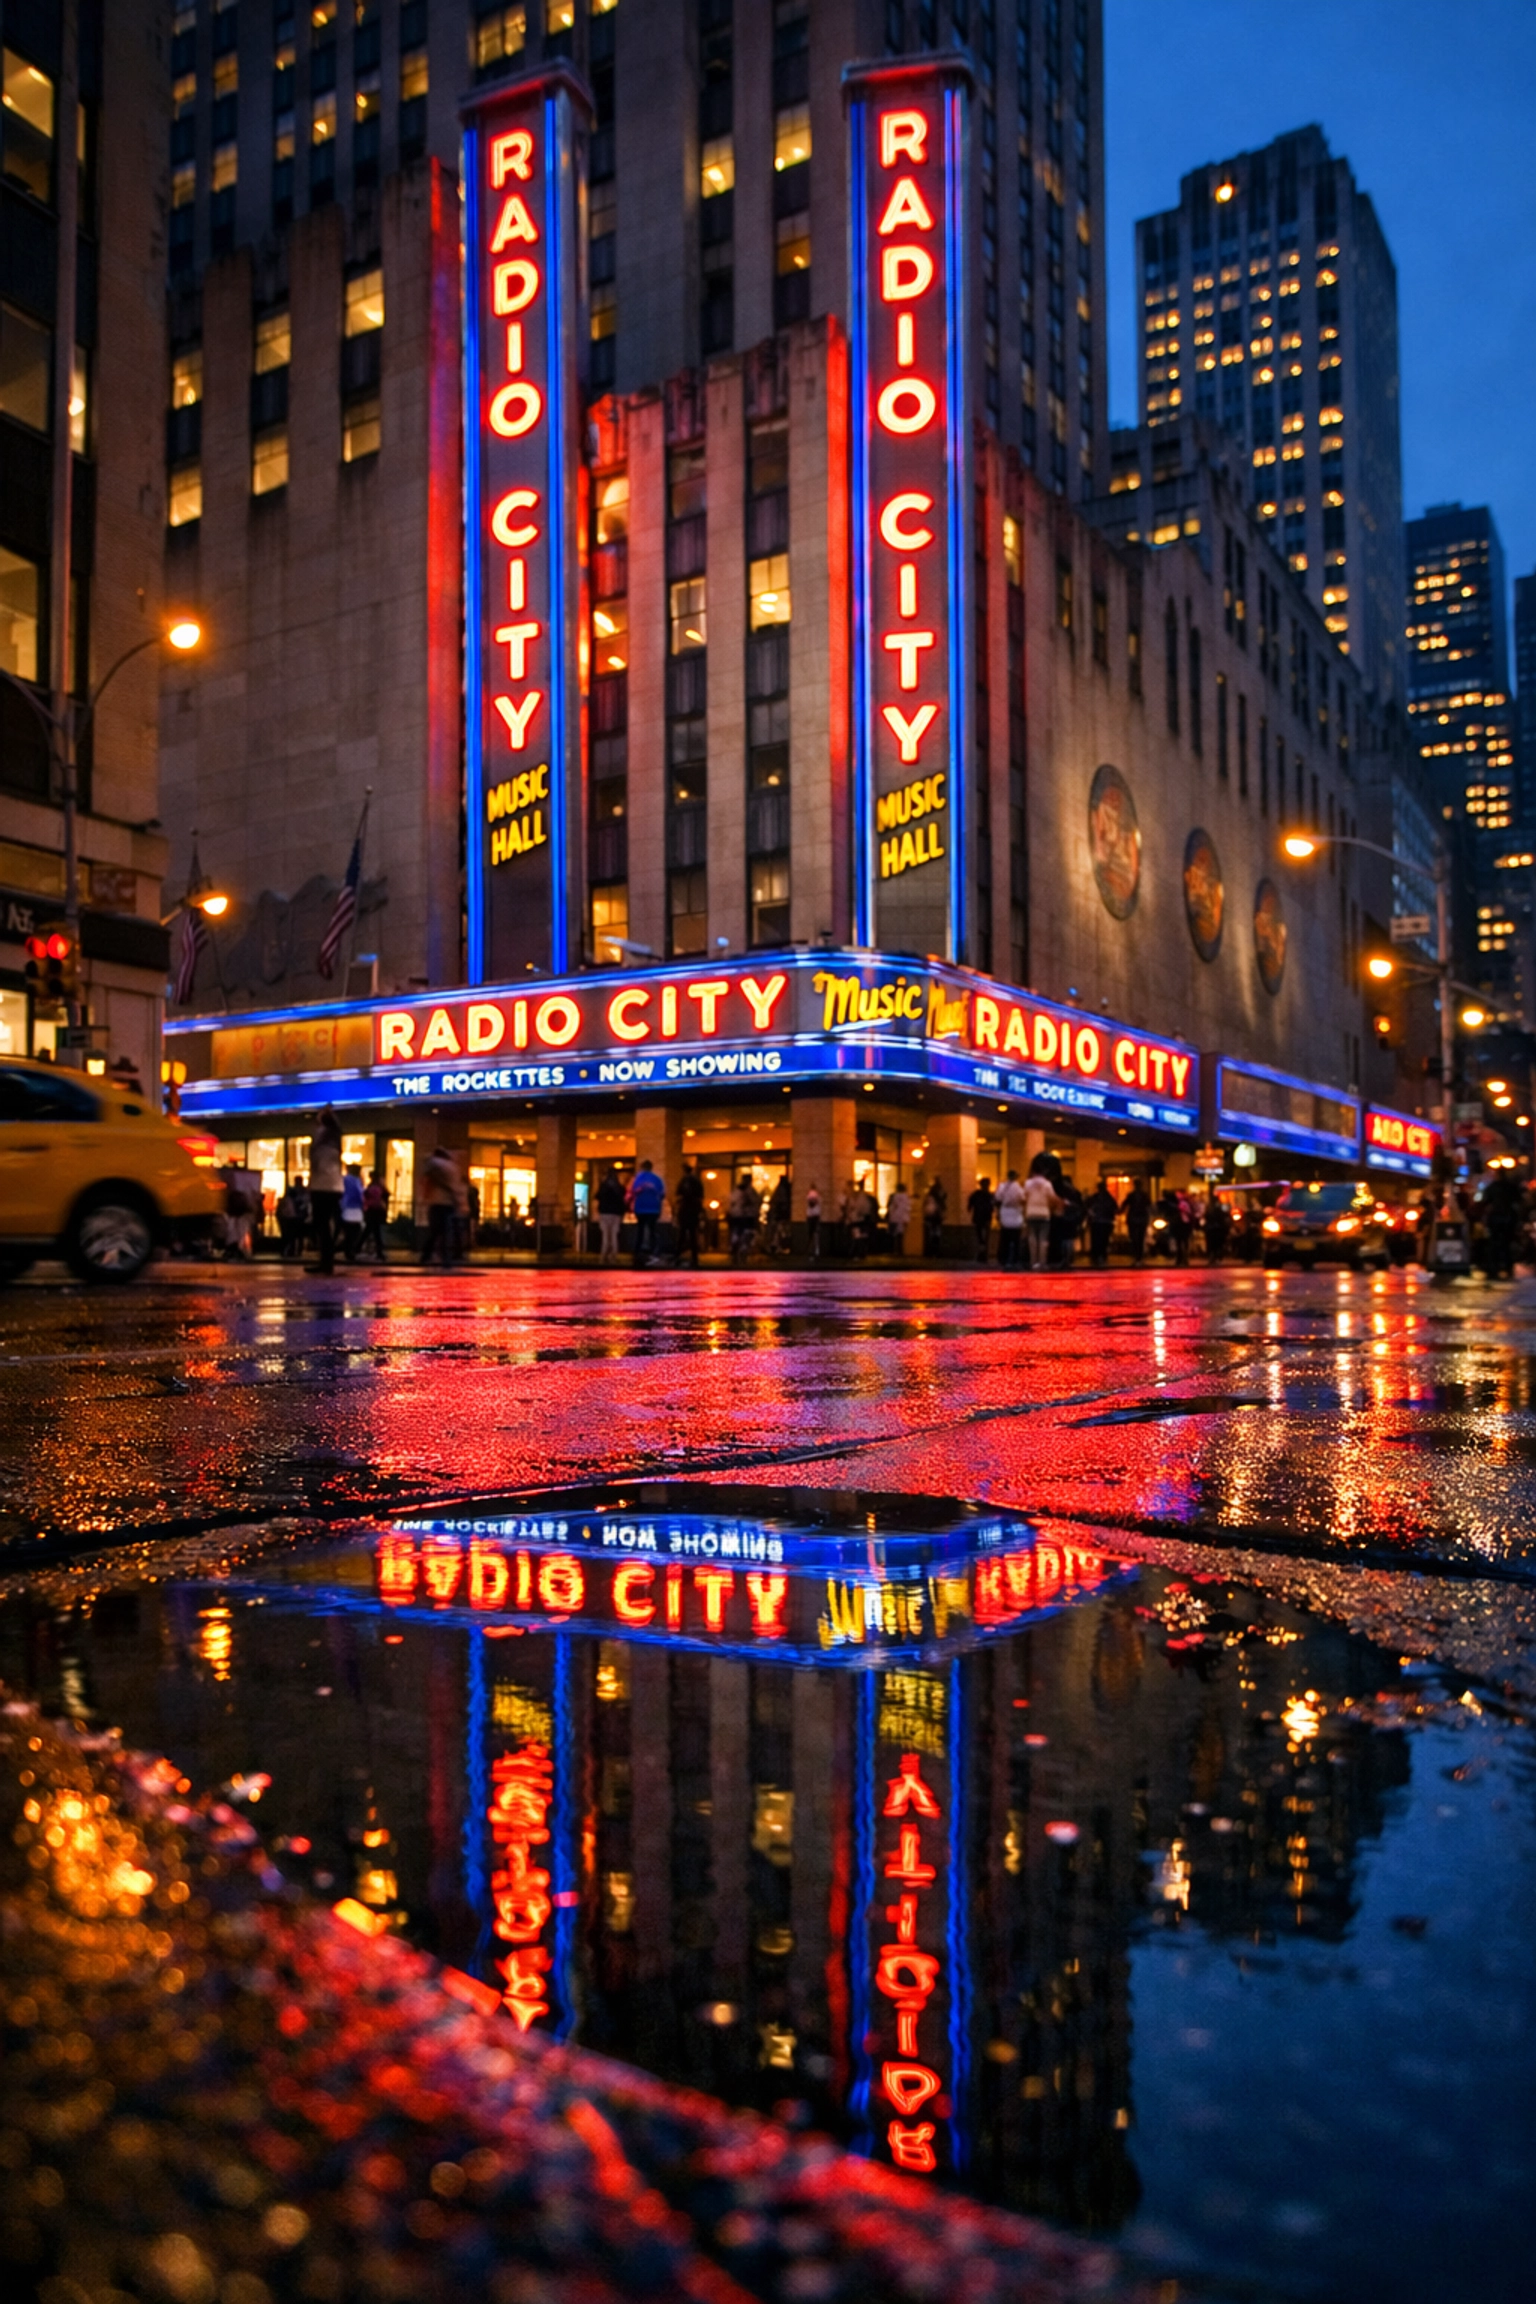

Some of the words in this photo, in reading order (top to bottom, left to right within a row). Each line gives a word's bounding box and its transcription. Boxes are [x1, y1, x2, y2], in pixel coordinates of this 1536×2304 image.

[490, 130, 542, 438] RADIO
[877, 110, 937, 435] RADIO
[490, 490, 542, 750] CITY
[880, 492, 938, 763] CITY
[487, 763, 548, 823] MUSIC
[877, 773, 946, 833] MUSIC
[491, 809, 547, 866] HALL
[881, 822, 945, 878] HALL
[379, 995, 581, 1060] RADIO
[607, 974, 787, 1041] CITY
[812, 970, 923, 1031] Music
[599, 1060, 655, 1083] NOW
[665, 1051, 782, 1079] SHOWING
[974, 995, 1100, 1074] RADIO
[1114, 1038, 1189, 1096] CITY
[392, 1075, 431, 1096] THE
[442, 1066, 565, 1092] ROCKETTES
